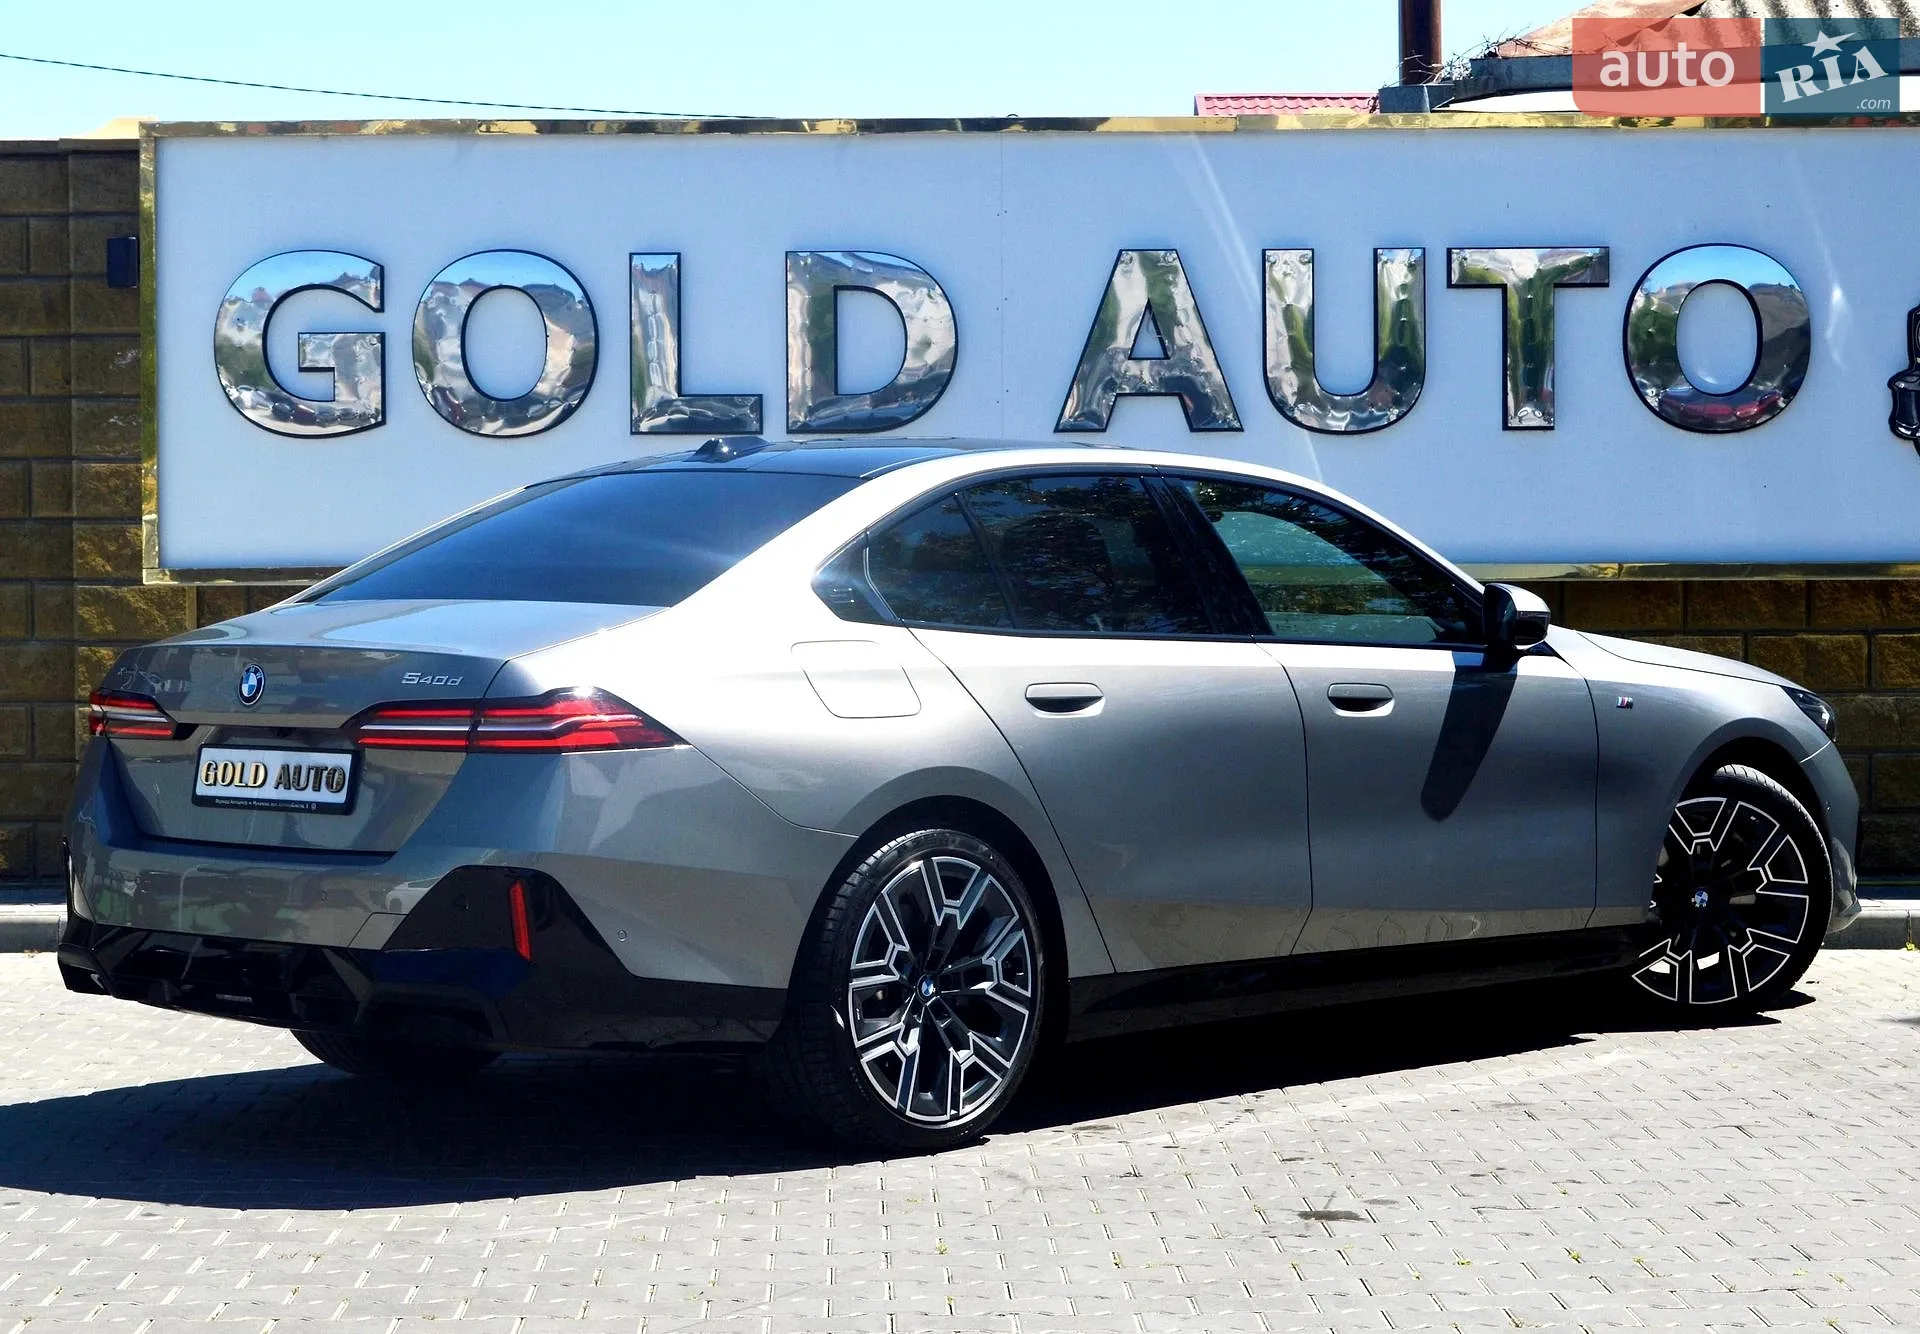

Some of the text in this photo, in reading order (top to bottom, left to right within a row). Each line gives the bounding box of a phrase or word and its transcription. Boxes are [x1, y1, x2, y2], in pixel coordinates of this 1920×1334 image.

[213, 243, 1811, 438] GOLD AUTO
[401, 671, 464, 687] 540d
[200, 760, 346, 793] GOLD AUTO
